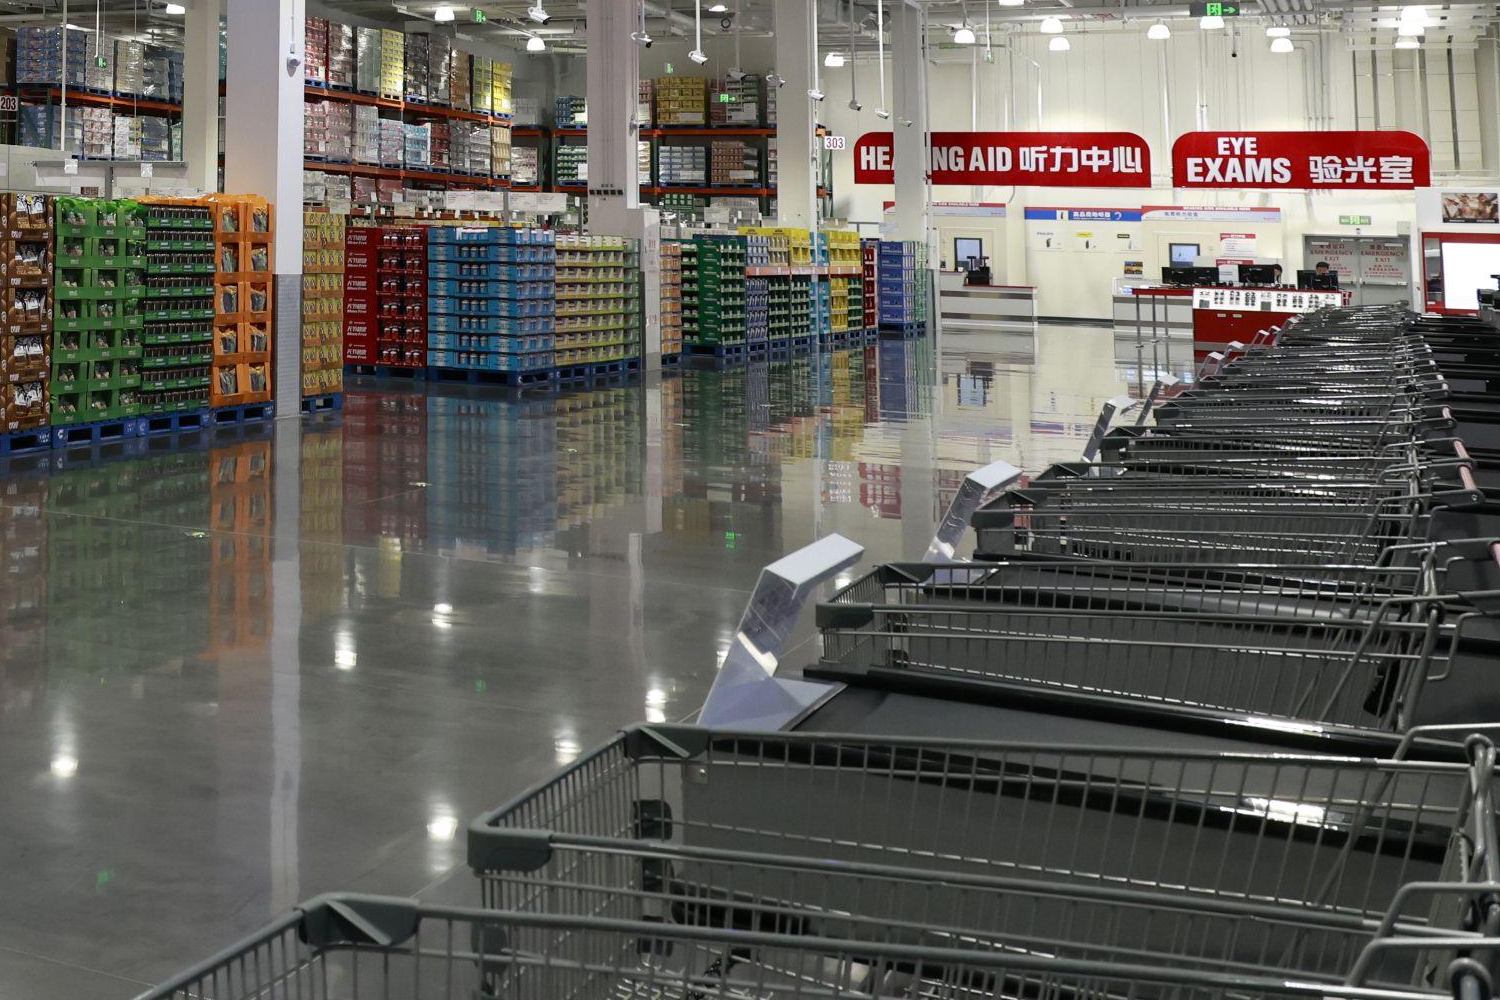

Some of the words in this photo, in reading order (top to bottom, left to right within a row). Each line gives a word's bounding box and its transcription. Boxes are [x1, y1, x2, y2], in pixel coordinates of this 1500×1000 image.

[0, 97, 17, 110] 203
[826, 137, 844, 149] 303
[1217, 137, 1258, 156] EYE
[861, 146, 964, 171] HENG
[969, 147, 1012, 172] AID
[1019, 145, 1143, 173] 听力中心
[1187, 157, 1292, 183] EXAMS
[1309, 155, 1414, 184] 验光室
